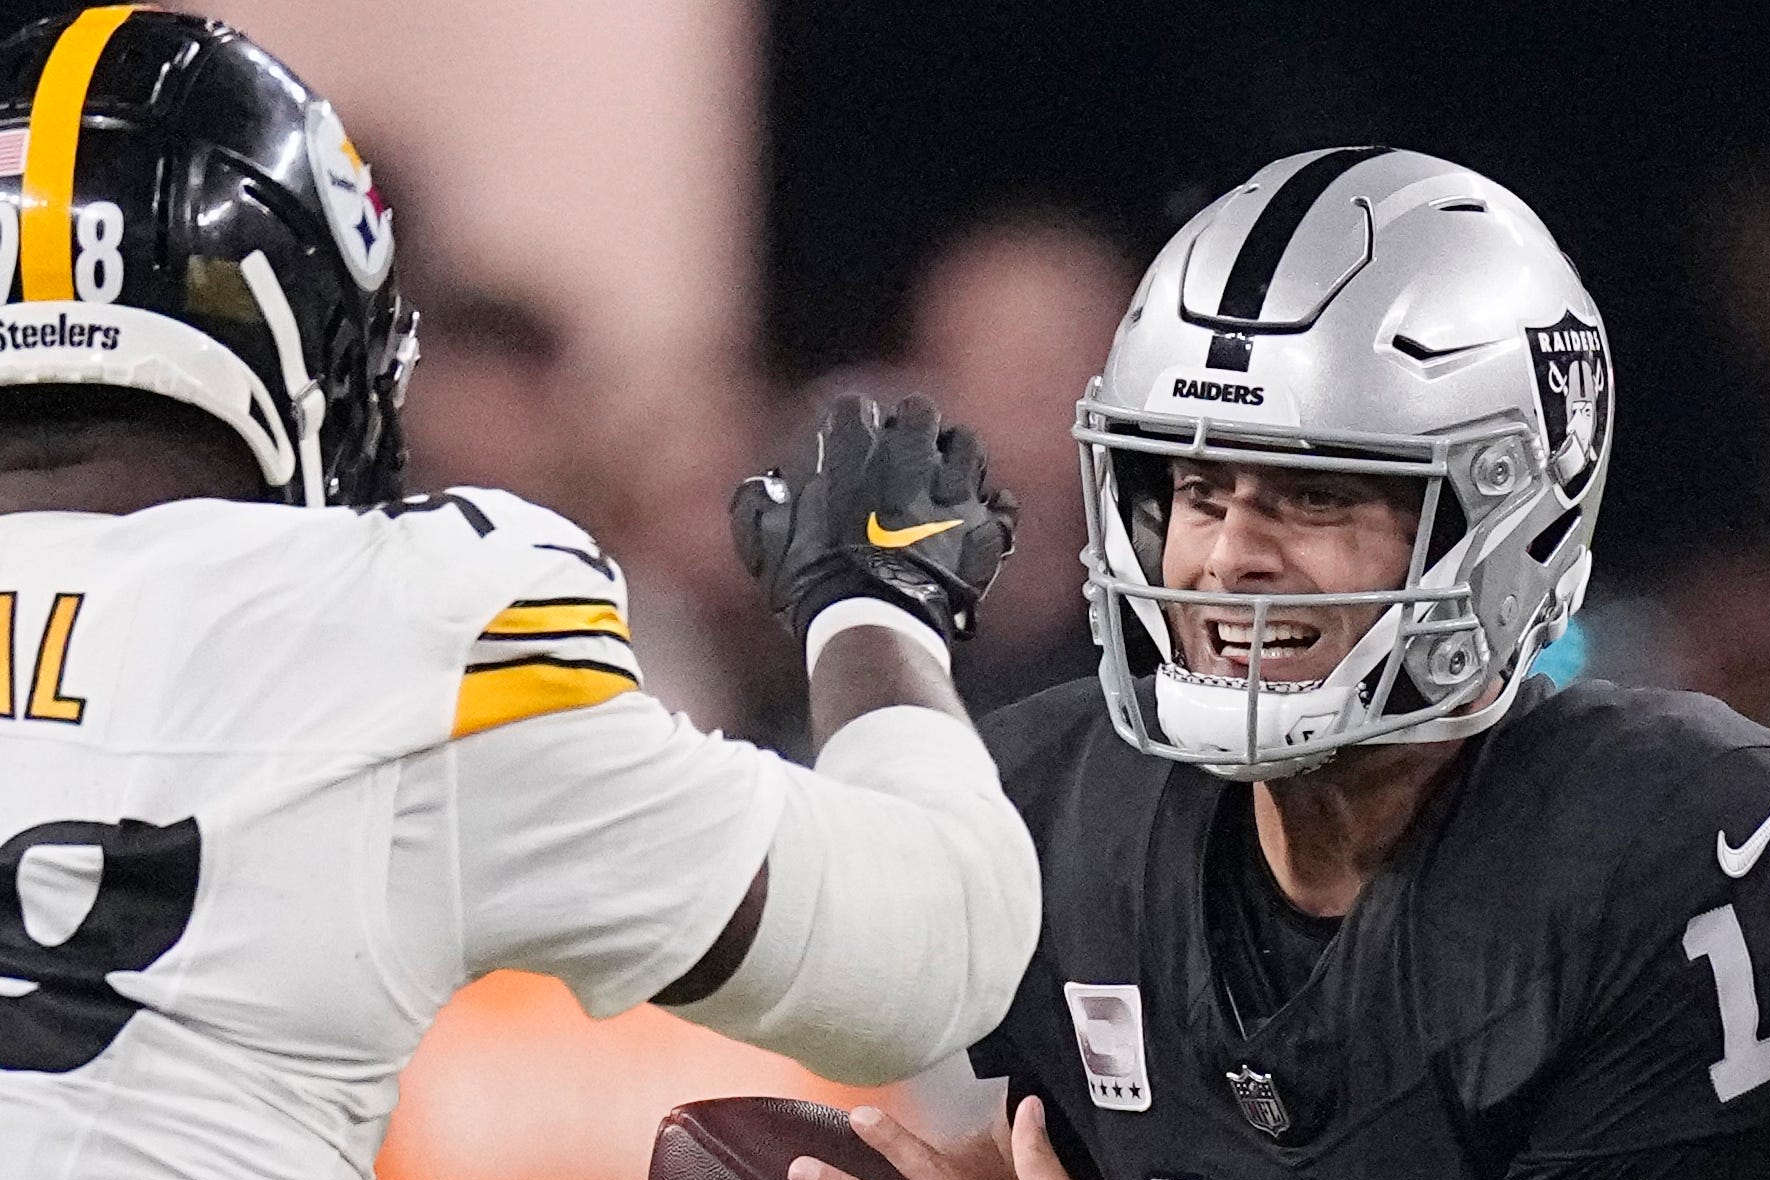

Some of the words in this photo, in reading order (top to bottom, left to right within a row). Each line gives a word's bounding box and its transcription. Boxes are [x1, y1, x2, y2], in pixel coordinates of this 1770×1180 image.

[1537, 328, 1601, 353] RAIDERS
[1172, 378, 1264, 406] RAIDERS
[0, 591, 87, 725] L
